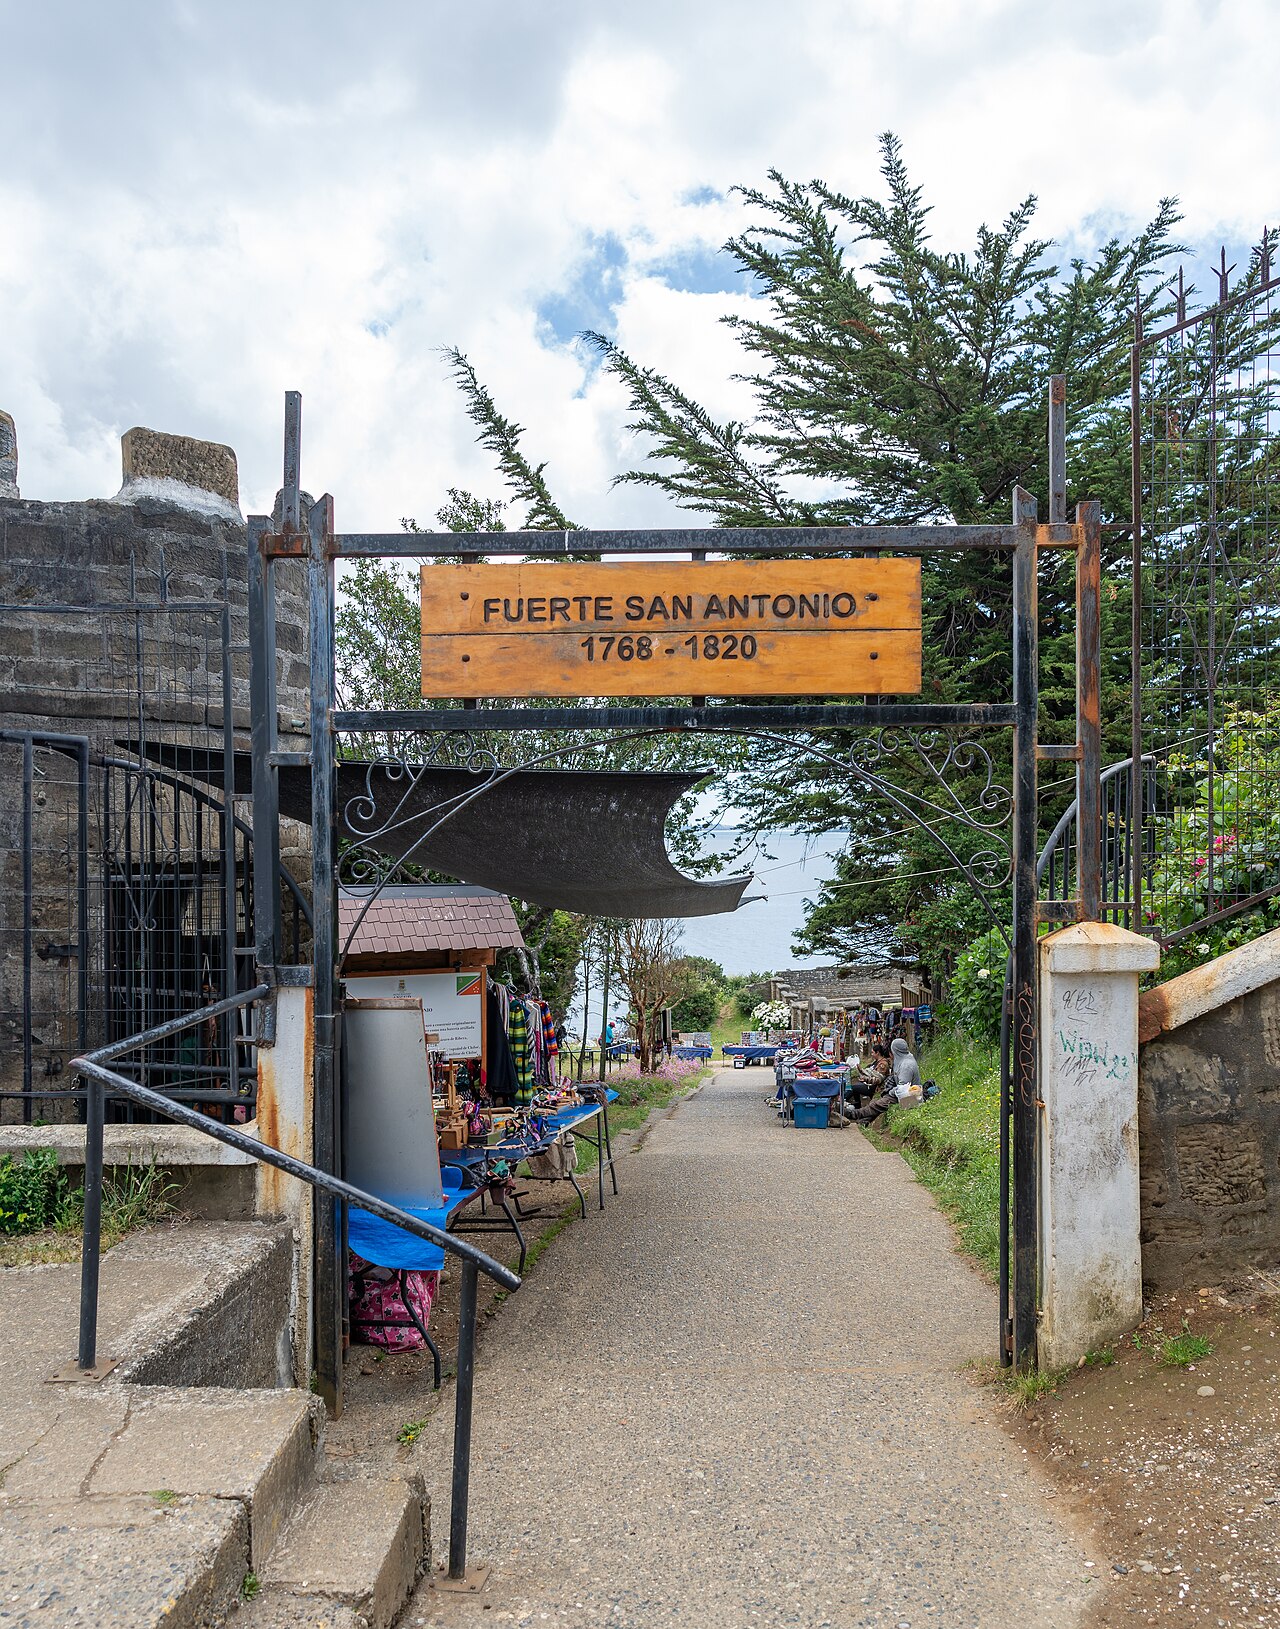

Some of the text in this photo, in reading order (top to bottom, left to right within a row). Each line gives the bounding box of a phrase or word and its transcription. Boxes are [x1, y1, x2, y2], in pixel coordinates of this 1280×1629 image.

[483, 592, 857, 623] FUERTE SAN ANTONIO
[580, 636, 653, 662] 1768
[684, 634, 758, 661] 1820
